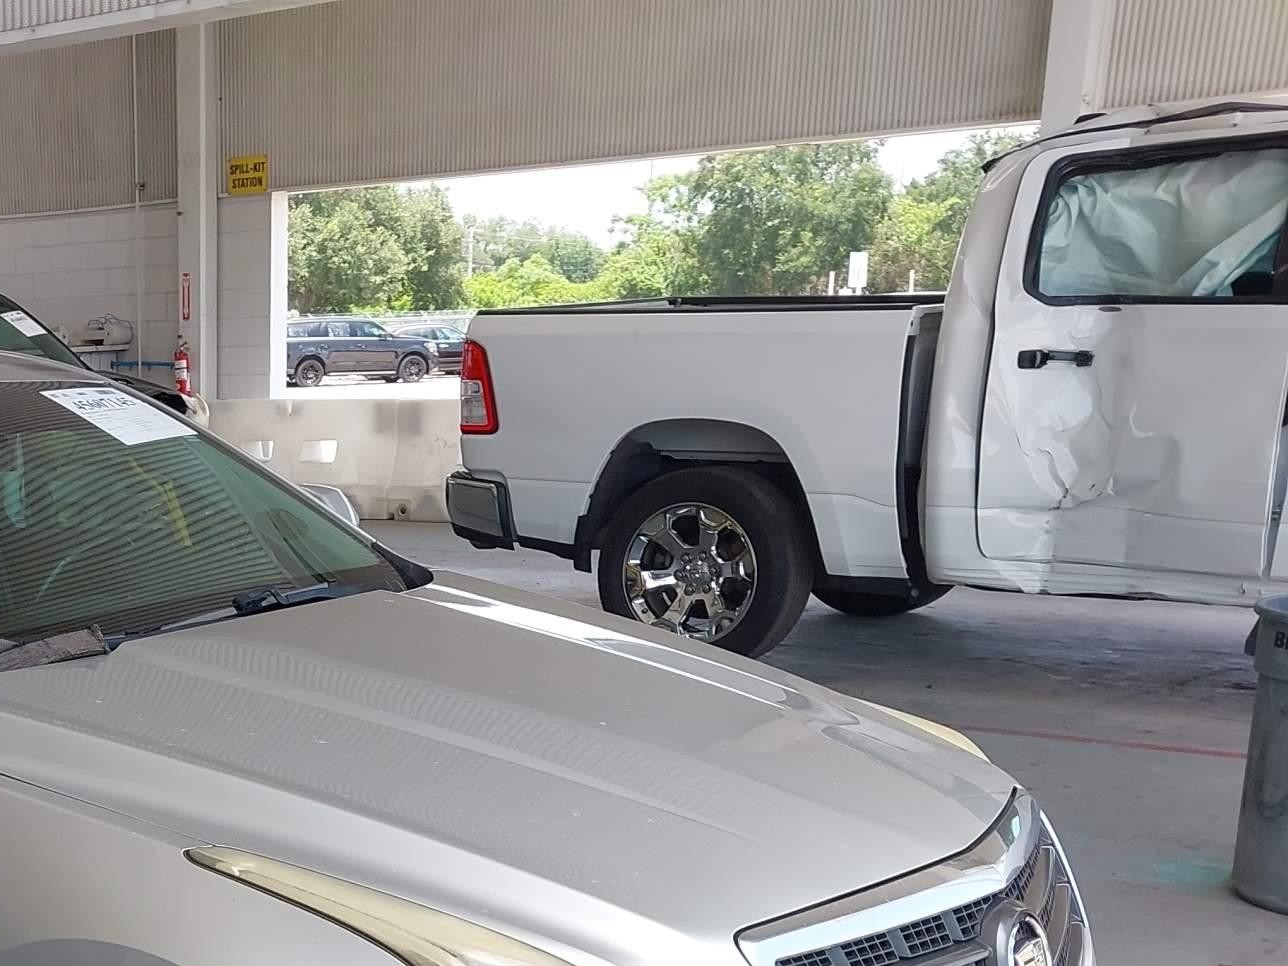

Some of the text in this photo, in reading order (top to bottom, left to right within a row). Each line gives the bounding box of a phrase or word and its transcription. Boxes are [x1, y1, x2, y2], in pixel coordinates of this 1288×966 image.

[230, 161, 266, 175] SPILL-KIT
[232, 176, 263, 189] STATION
[1273, 630, 1288, 650] B
